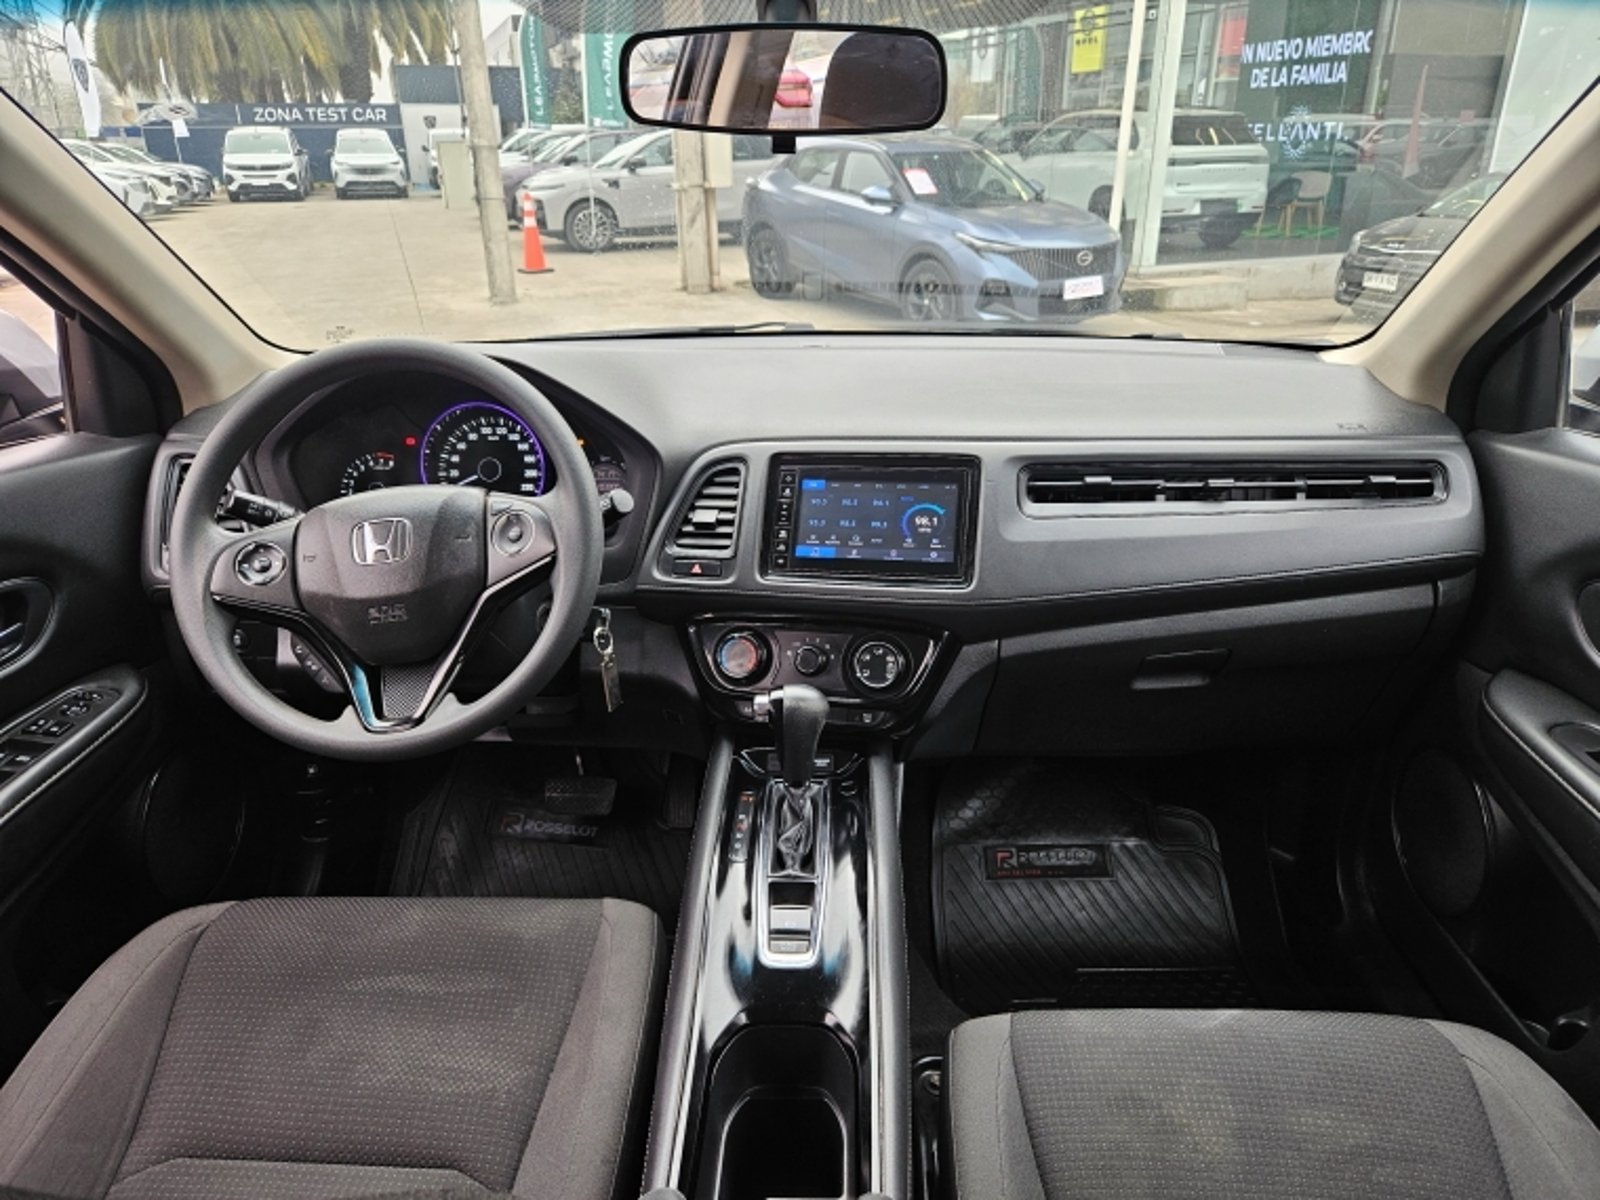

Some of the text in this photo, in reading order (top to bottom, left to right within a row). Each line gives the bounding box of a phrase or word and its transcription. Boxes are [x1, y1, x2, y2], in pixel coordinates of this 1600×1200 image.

[1256, 37, 1303, 62] NUEVO
[1250, 61, 1348, 89] DE LA FAMILIA
[253, 107, 388, 123] ZONA TEST CAR
